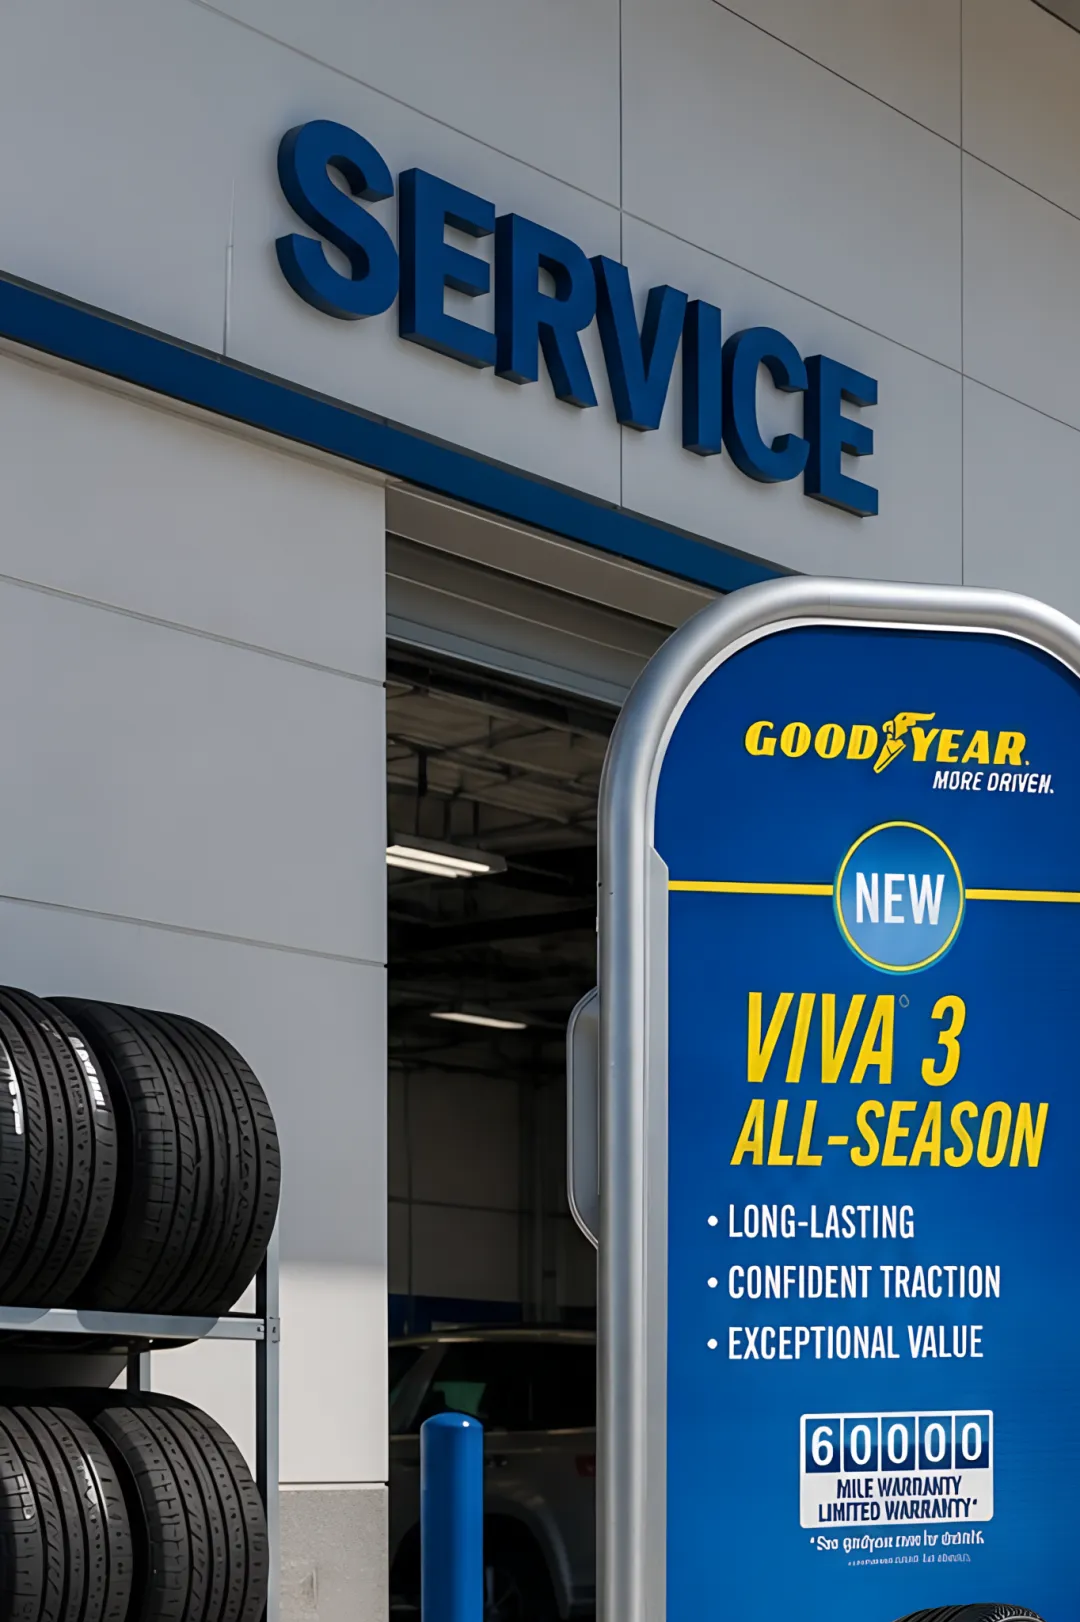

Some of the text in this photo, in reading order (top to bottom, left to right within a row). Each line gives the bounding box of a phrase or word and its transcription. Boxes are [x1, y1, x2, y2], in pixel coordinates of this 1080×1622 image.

[276, 119, 879, 517] SERVICE
[932, 771, 984, 790] MORE
[855, 872, 945, 925] NEW
[746, 992, 966, 1086] VIVA 3
[730, 1099, 1049, 1168] ALL-SEASON
[729, 1204, 915, 1239] LONG-LASTING
[728, 1265, 1001, 1299] CONFIDENT TRACTION
[728, 1325, 984, 1360] EXCEPTIONAL VALUE
[811, 1422, 982, 1466] 60000
[837, 1478, 873, 1499] MILE
[818, 1502, 880, 1522] LIMITED
